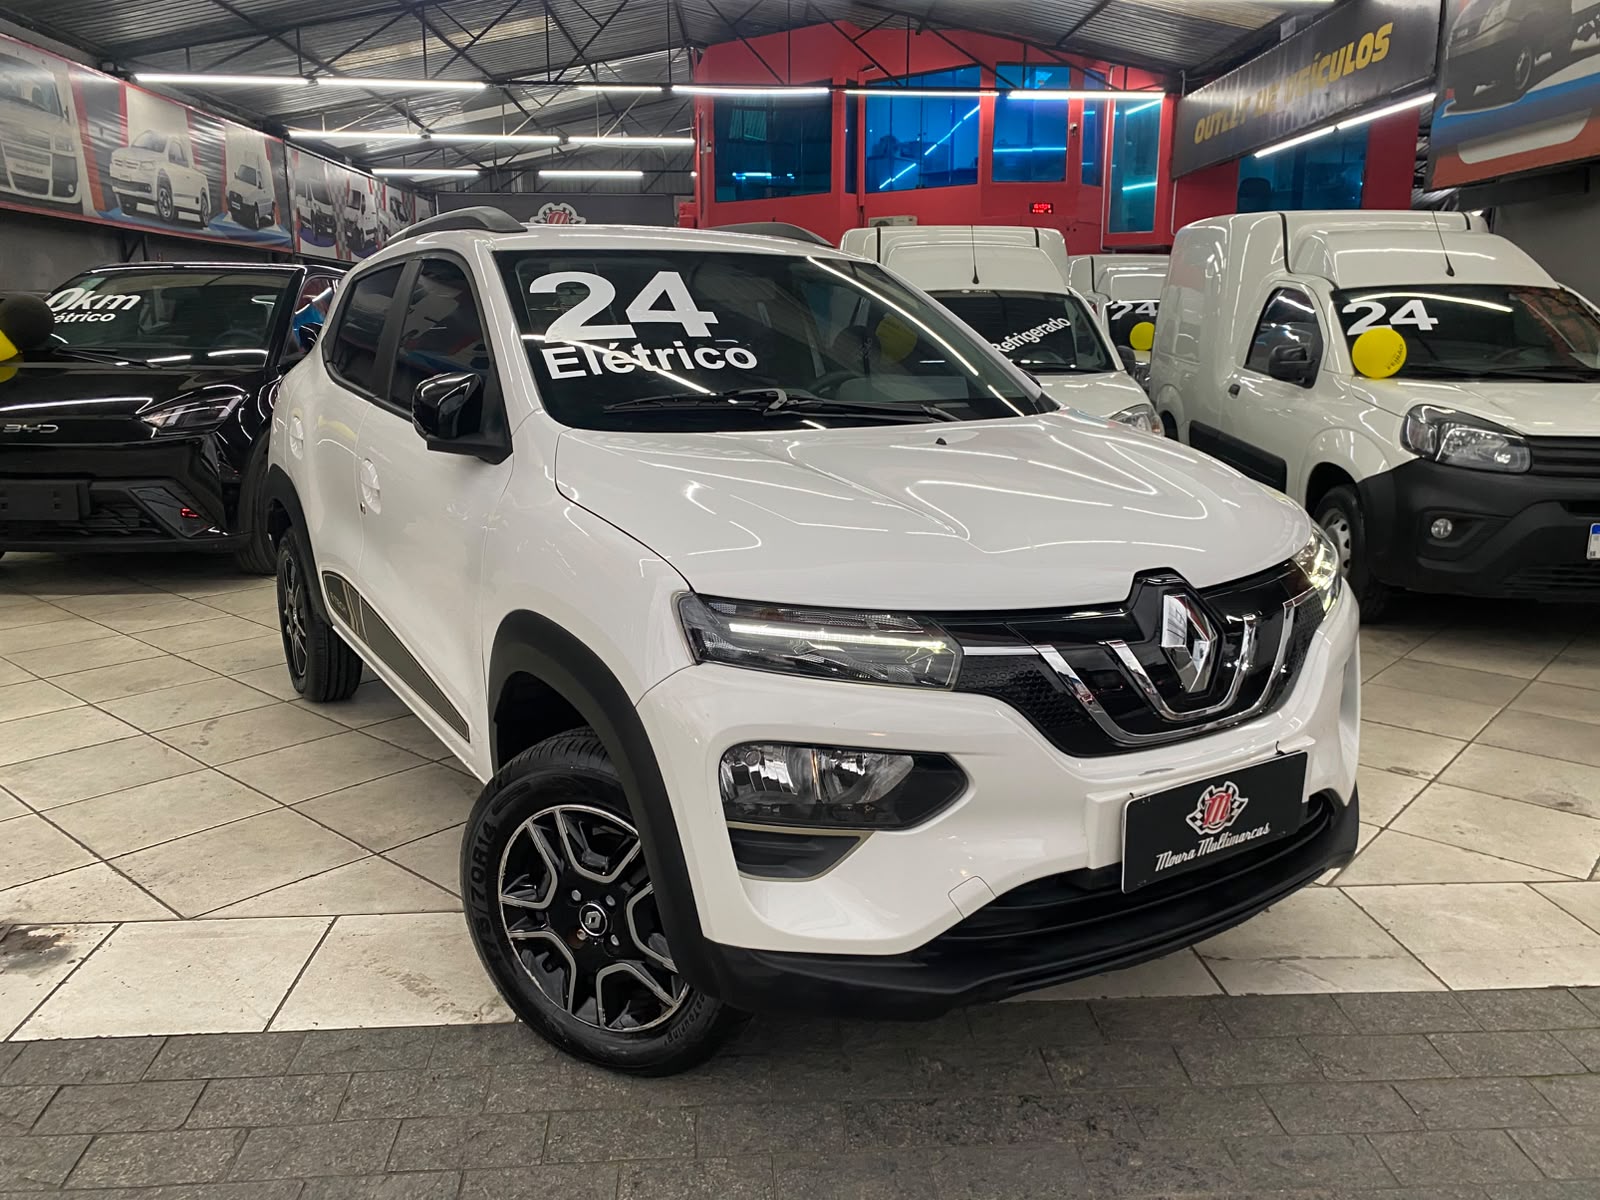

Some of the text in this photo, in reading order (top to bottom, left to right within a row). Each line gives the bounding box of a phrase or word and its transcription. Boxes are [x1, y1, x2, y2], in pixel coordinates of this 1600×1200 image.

[529, 271, 719, 344] 24
[1342, 299, 1439, 336] 24
[541, 341, 758, 380] Elétrico
[1155, 822, 1271, 872] Moura Multimarcas
